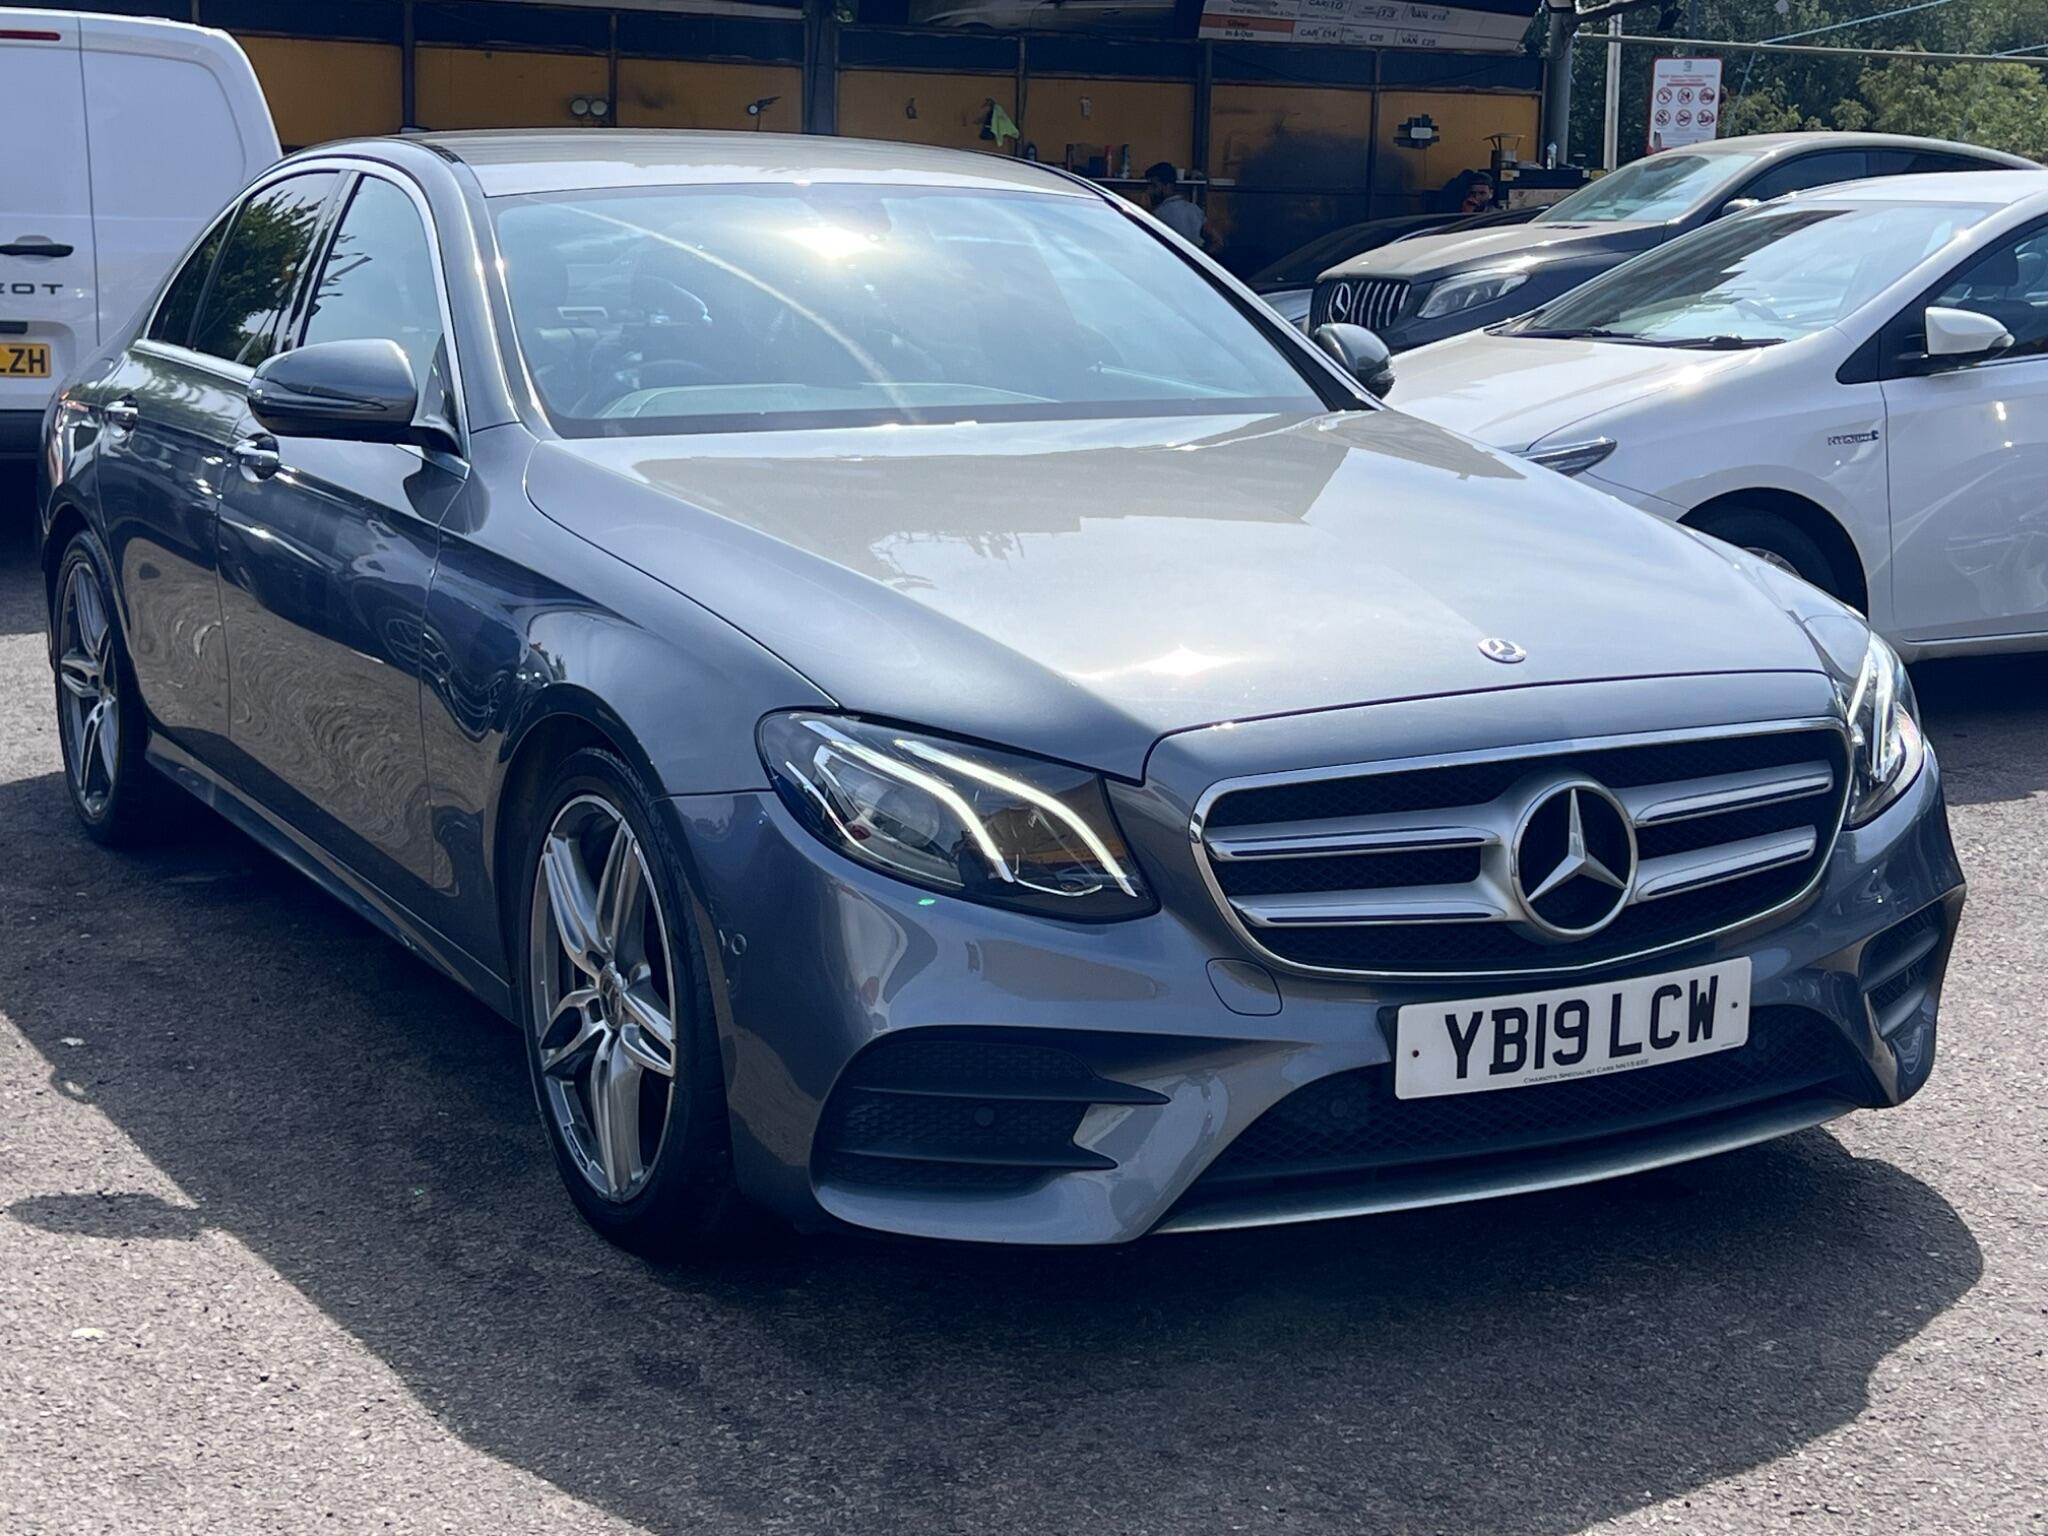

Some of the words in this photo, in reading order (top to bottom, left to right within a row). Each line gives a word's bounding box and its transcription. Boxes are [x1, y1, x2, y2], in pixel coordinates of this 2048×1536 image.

[0, 283, 63, 295] OT
[1444, 999, 1590, 1079] YB19
[1608, 975, 1719, 1058] LCW
